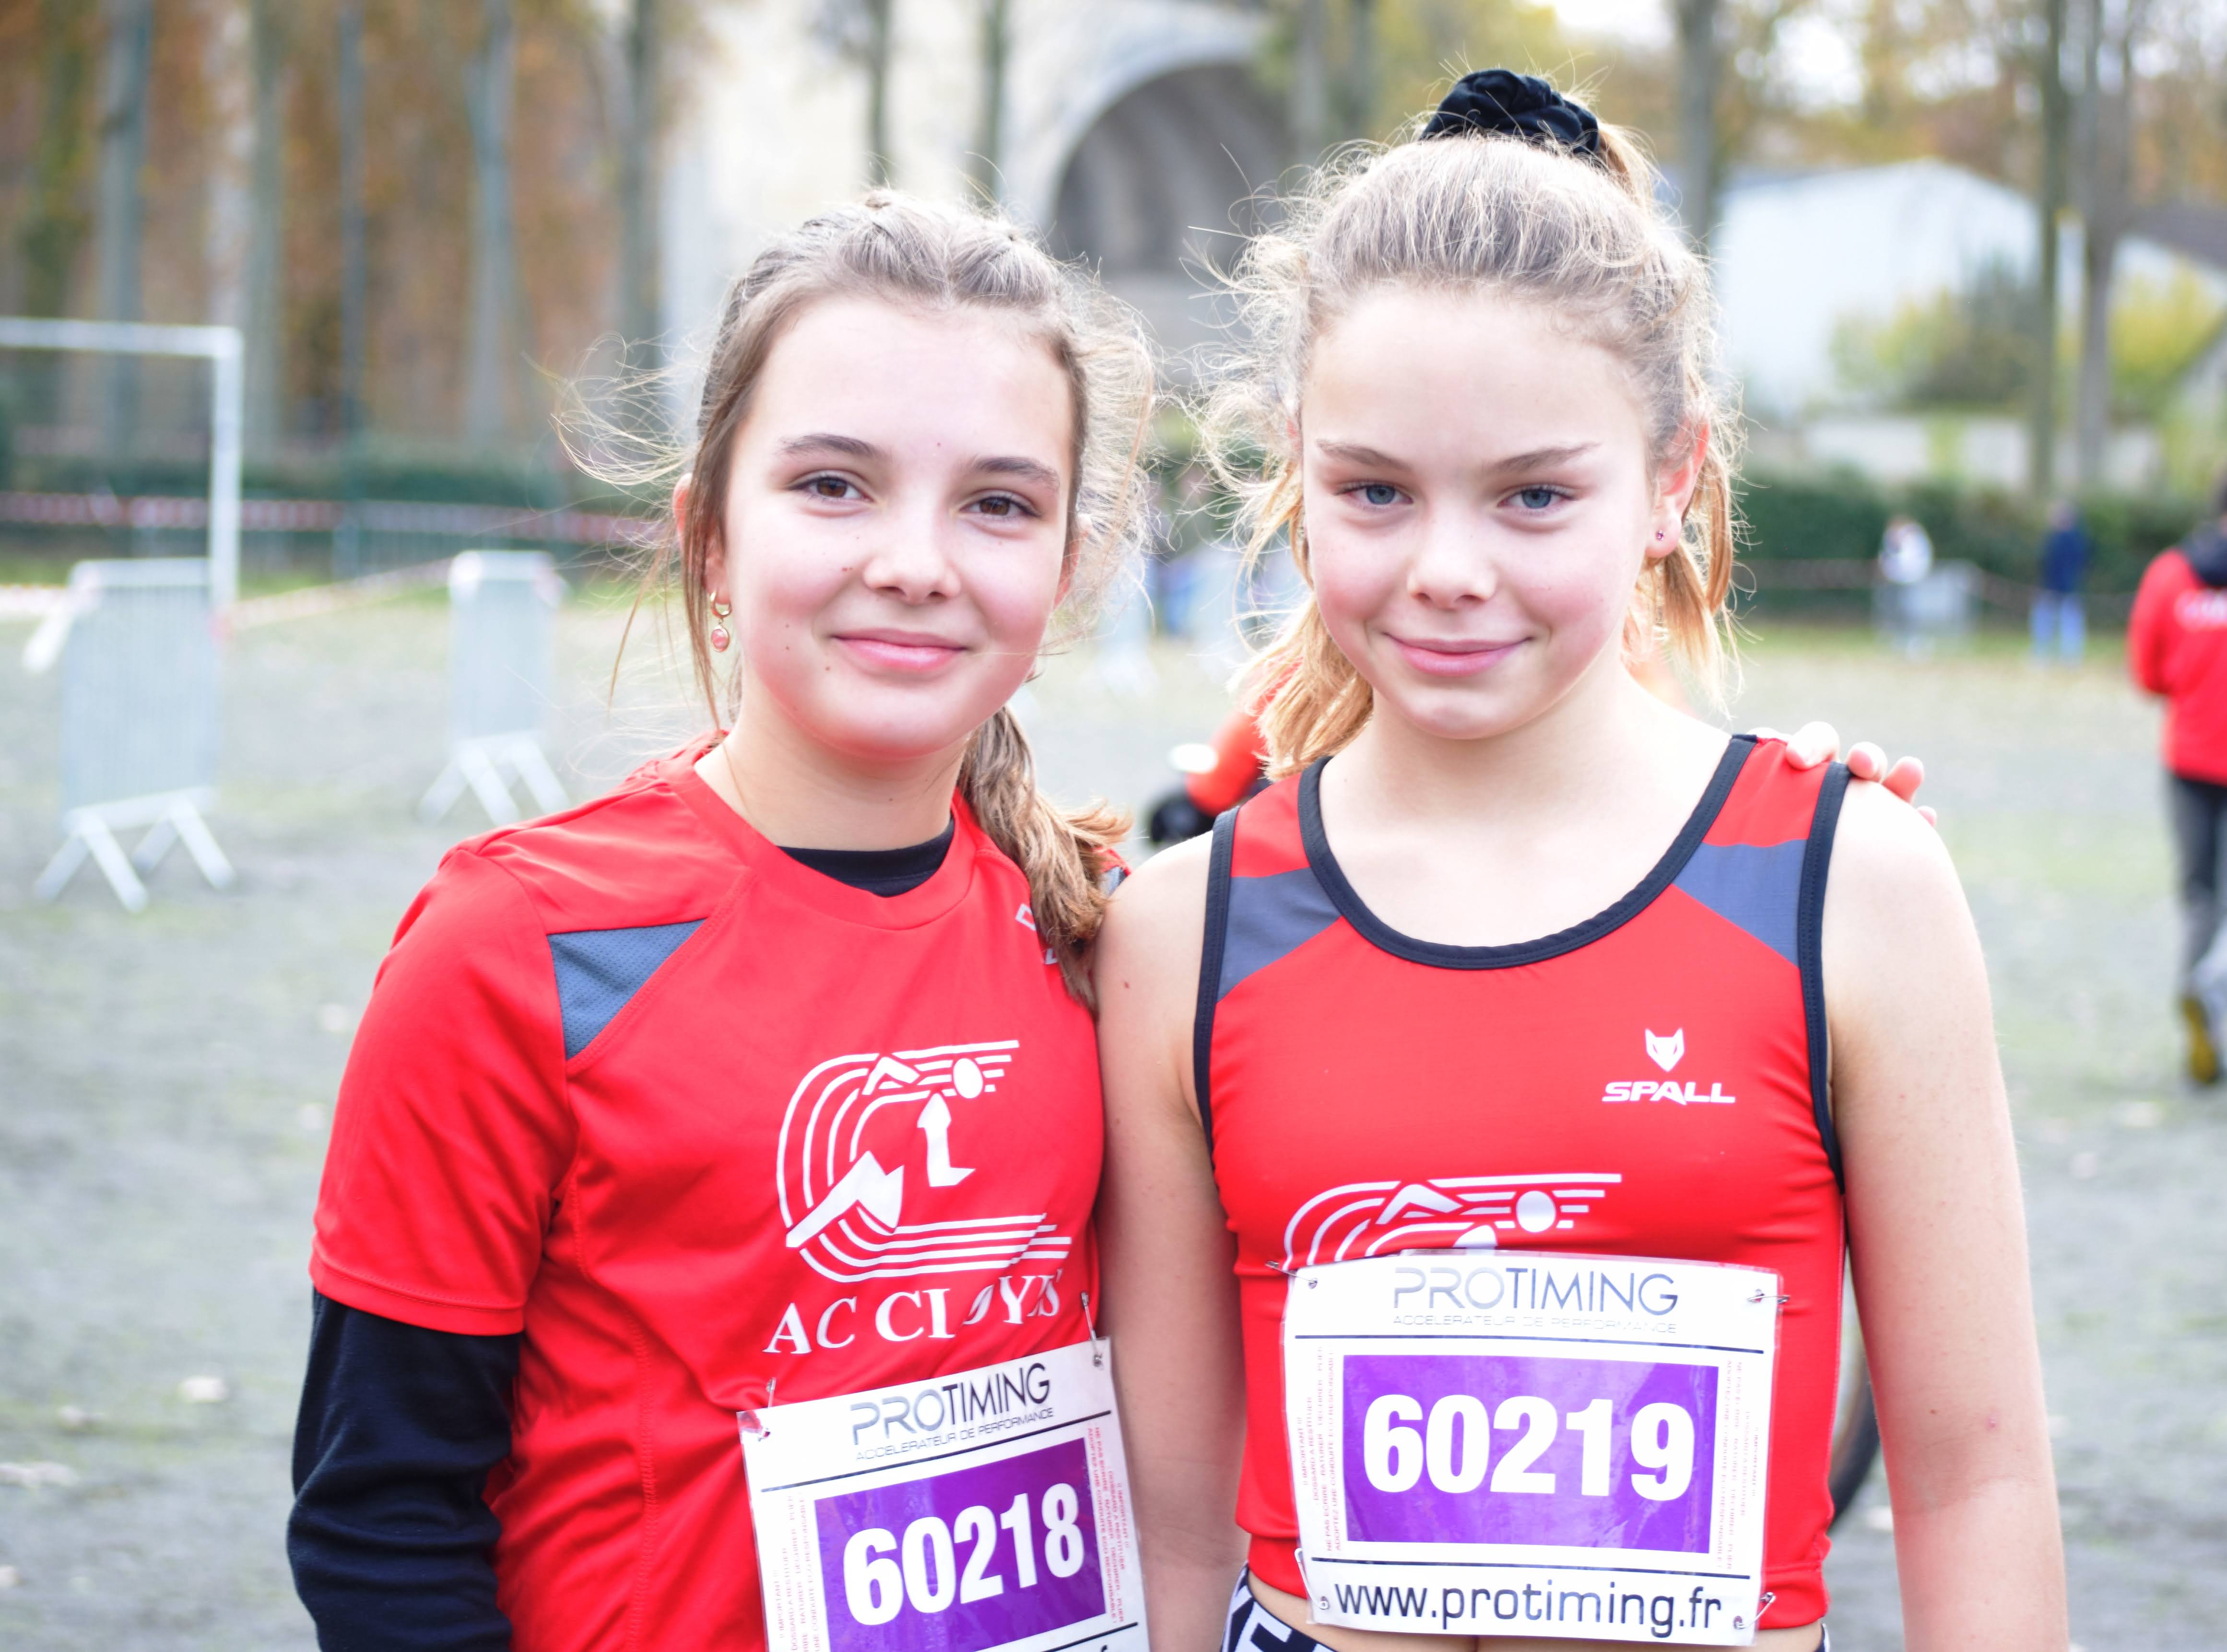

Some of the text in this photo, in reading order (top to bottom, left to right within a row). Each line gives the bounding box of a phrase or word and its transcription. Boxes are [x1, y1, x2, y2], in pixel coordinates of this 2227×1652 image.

[1602, 1081, 1736, 1105] SPALL
[1392, 1266, 1678, 1315] PROTIMING
[763, 1296, 857, 1354] AC
[1392, 1315, 1516, 1325] ACCELERATEUR
[1522, 1317, 1544, 1327] DE
[850, 1362, 1050, 1446] PROTIMING
[856, 1406, 1054, 1462] ACCELERATEUR DE PERFORMANCE
[1364, 1394, 1696, 1501] 60219
[843, 1483, 1085, 1626] 60218
[1335, 1580, 1722, 1638] www.protiming.fr
